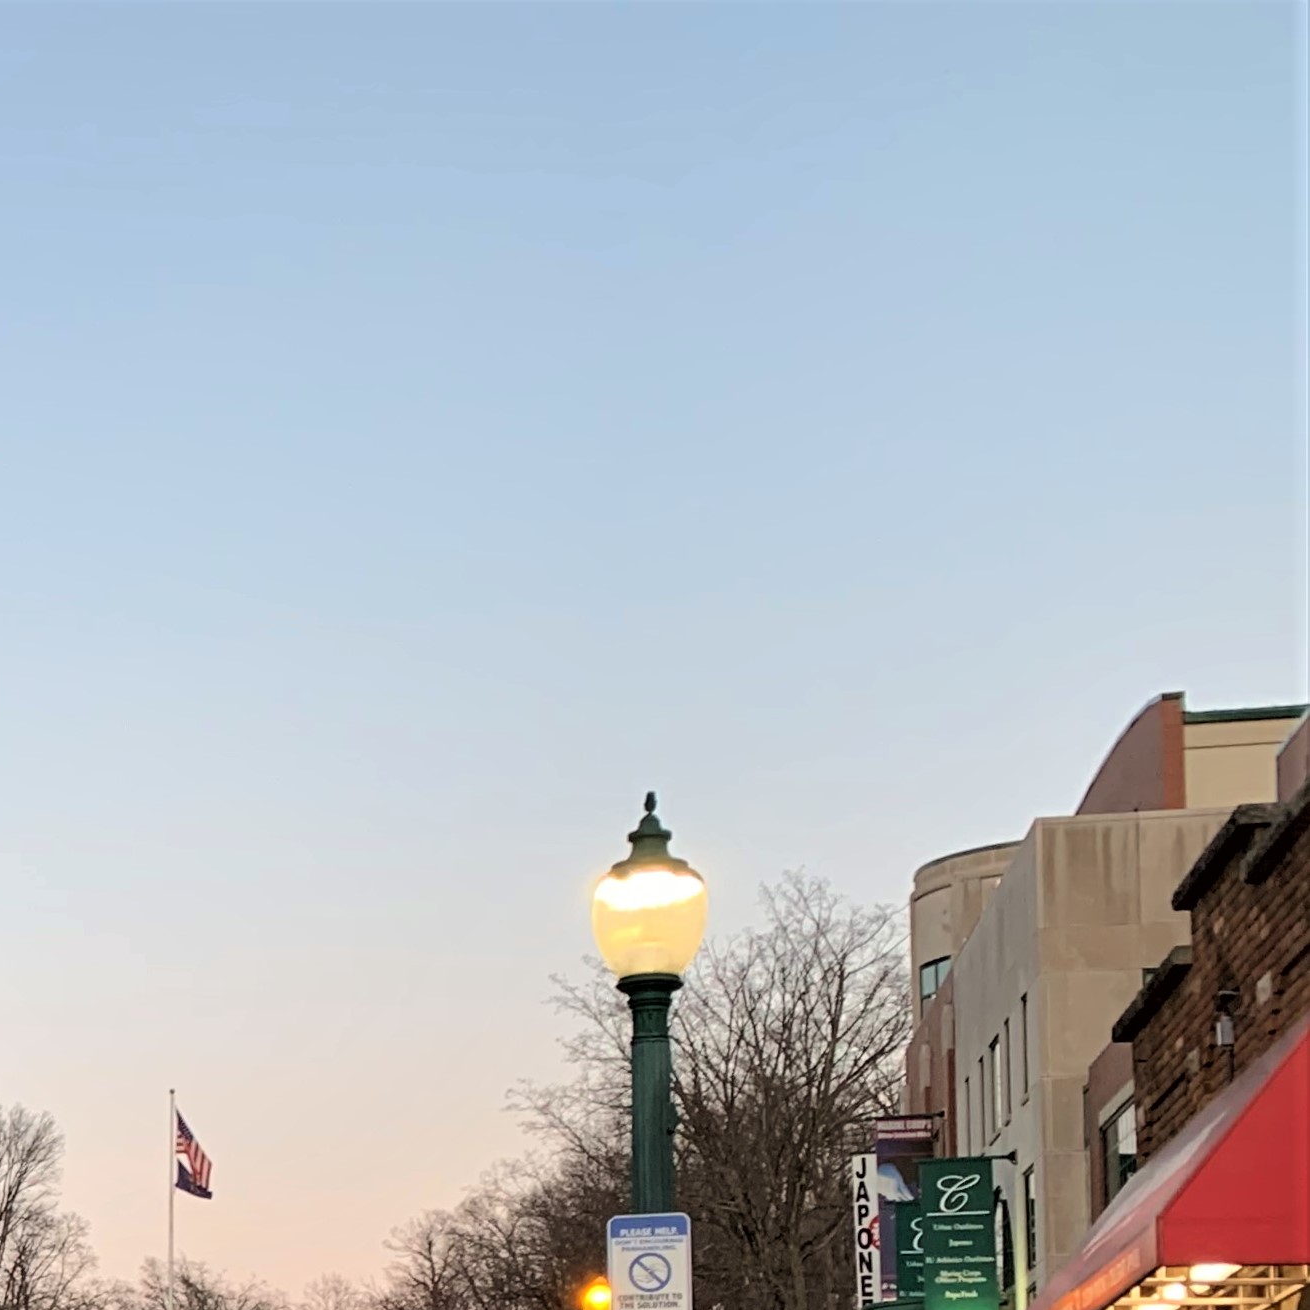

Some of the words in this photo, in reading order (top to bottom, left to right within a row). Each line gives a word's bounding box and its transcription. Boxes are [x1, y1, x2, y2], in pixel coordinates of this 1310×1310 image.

[617, 1293, 669, 1302] CONTRIBUTE
[672, 1292, 683, 1300] TO
[619, 1302, 634, 1310] THE
